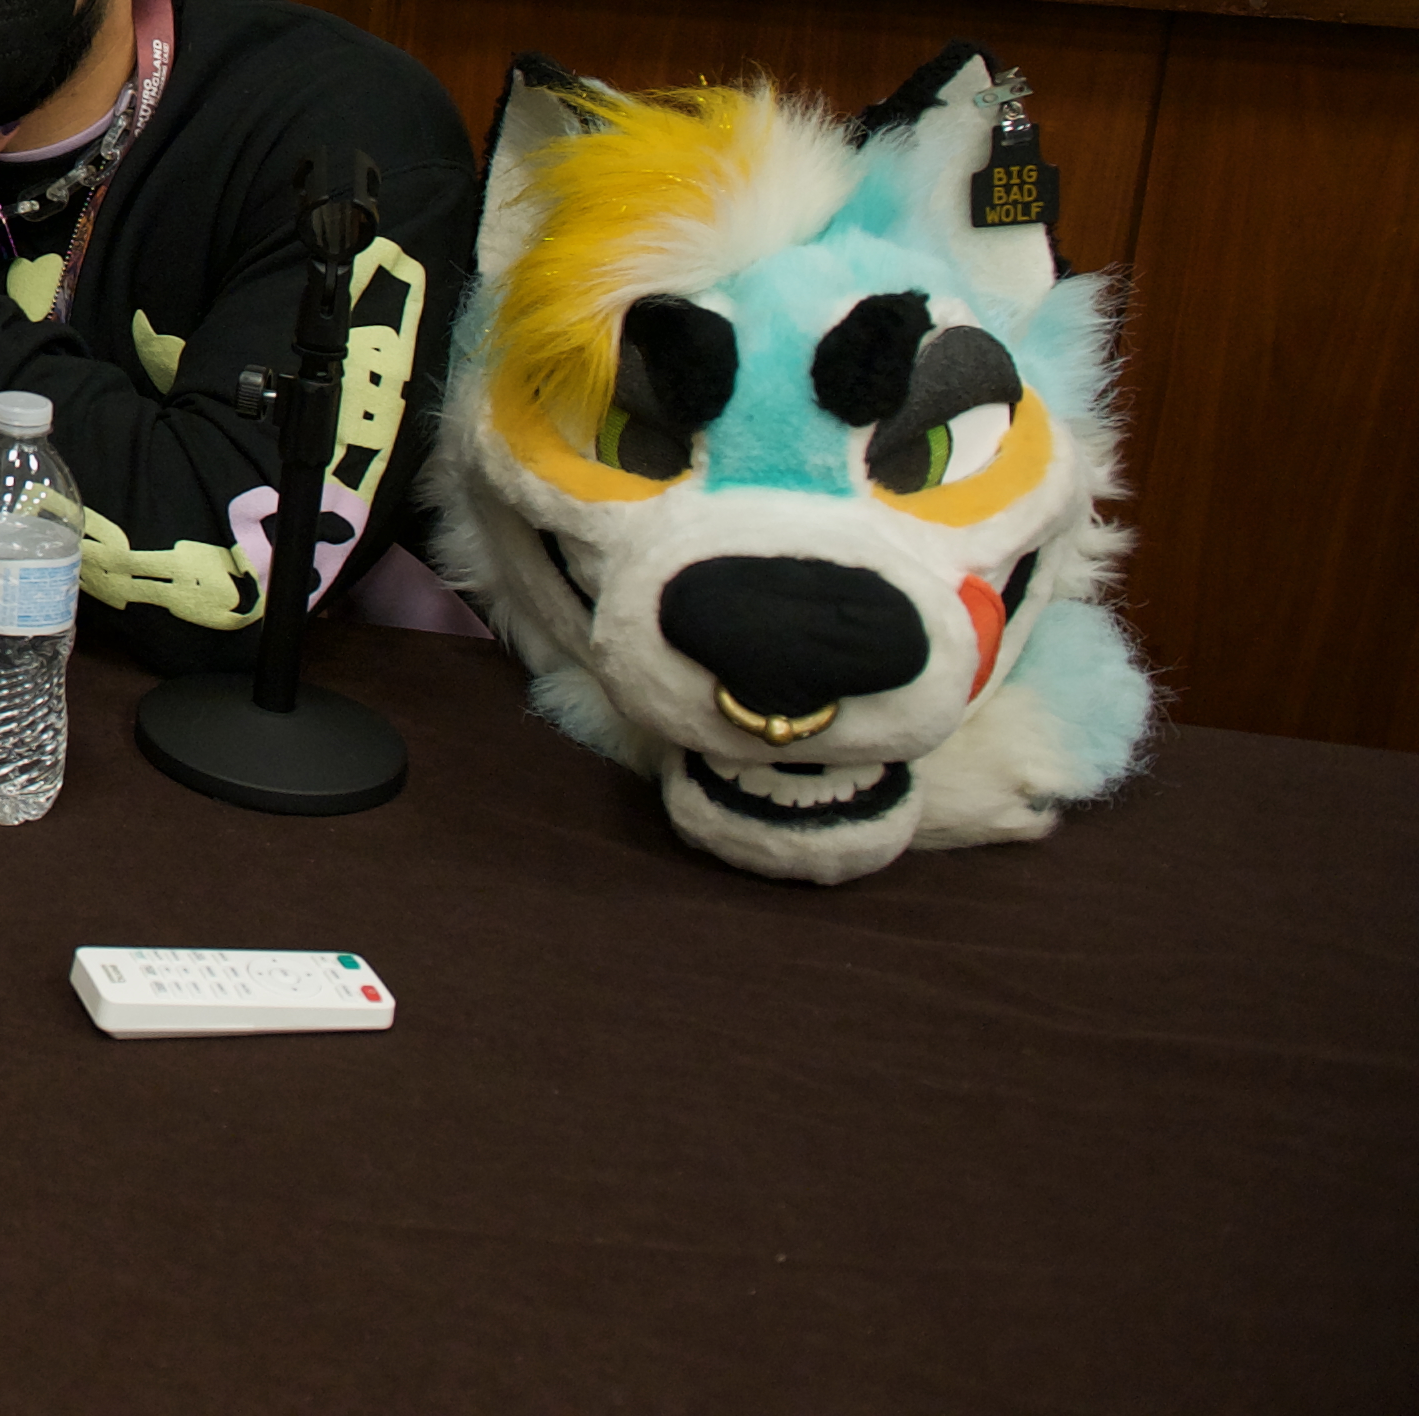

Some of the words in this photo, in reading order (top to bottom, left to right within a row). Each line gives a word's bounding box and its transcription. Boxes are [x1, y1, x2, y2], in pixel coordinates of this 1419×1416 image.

[993, 165, 1038, 185] BIG
[993, 184, 1037, 204] BAD
[985, 202, 1044, 223] WOLF
